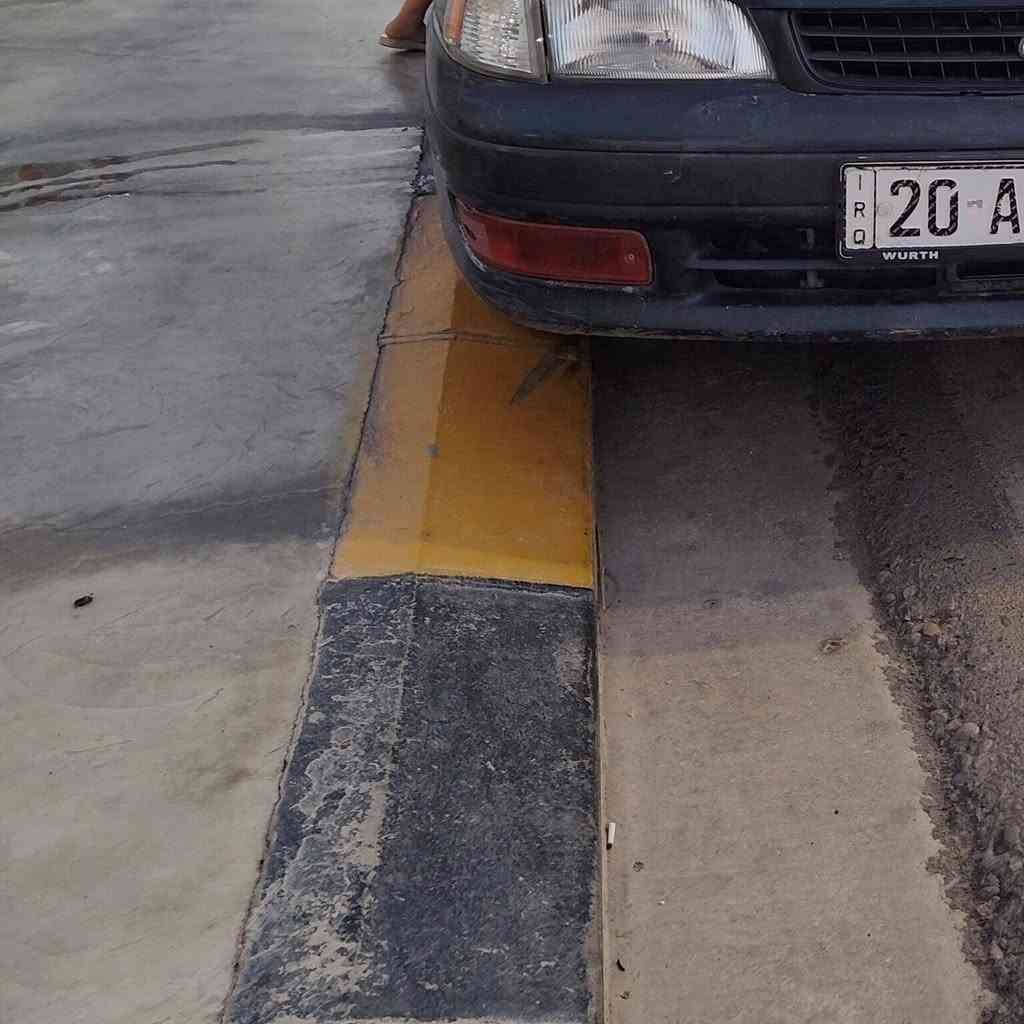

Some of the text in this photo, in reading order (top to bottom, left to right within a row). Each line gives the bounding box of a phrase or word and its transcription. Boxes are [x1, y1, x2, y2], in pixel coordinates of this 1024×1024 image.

[889, 179, 960, 237] 20
[990, 178, 1021, 235] A
[882, 250, 939, 261] WURTH
